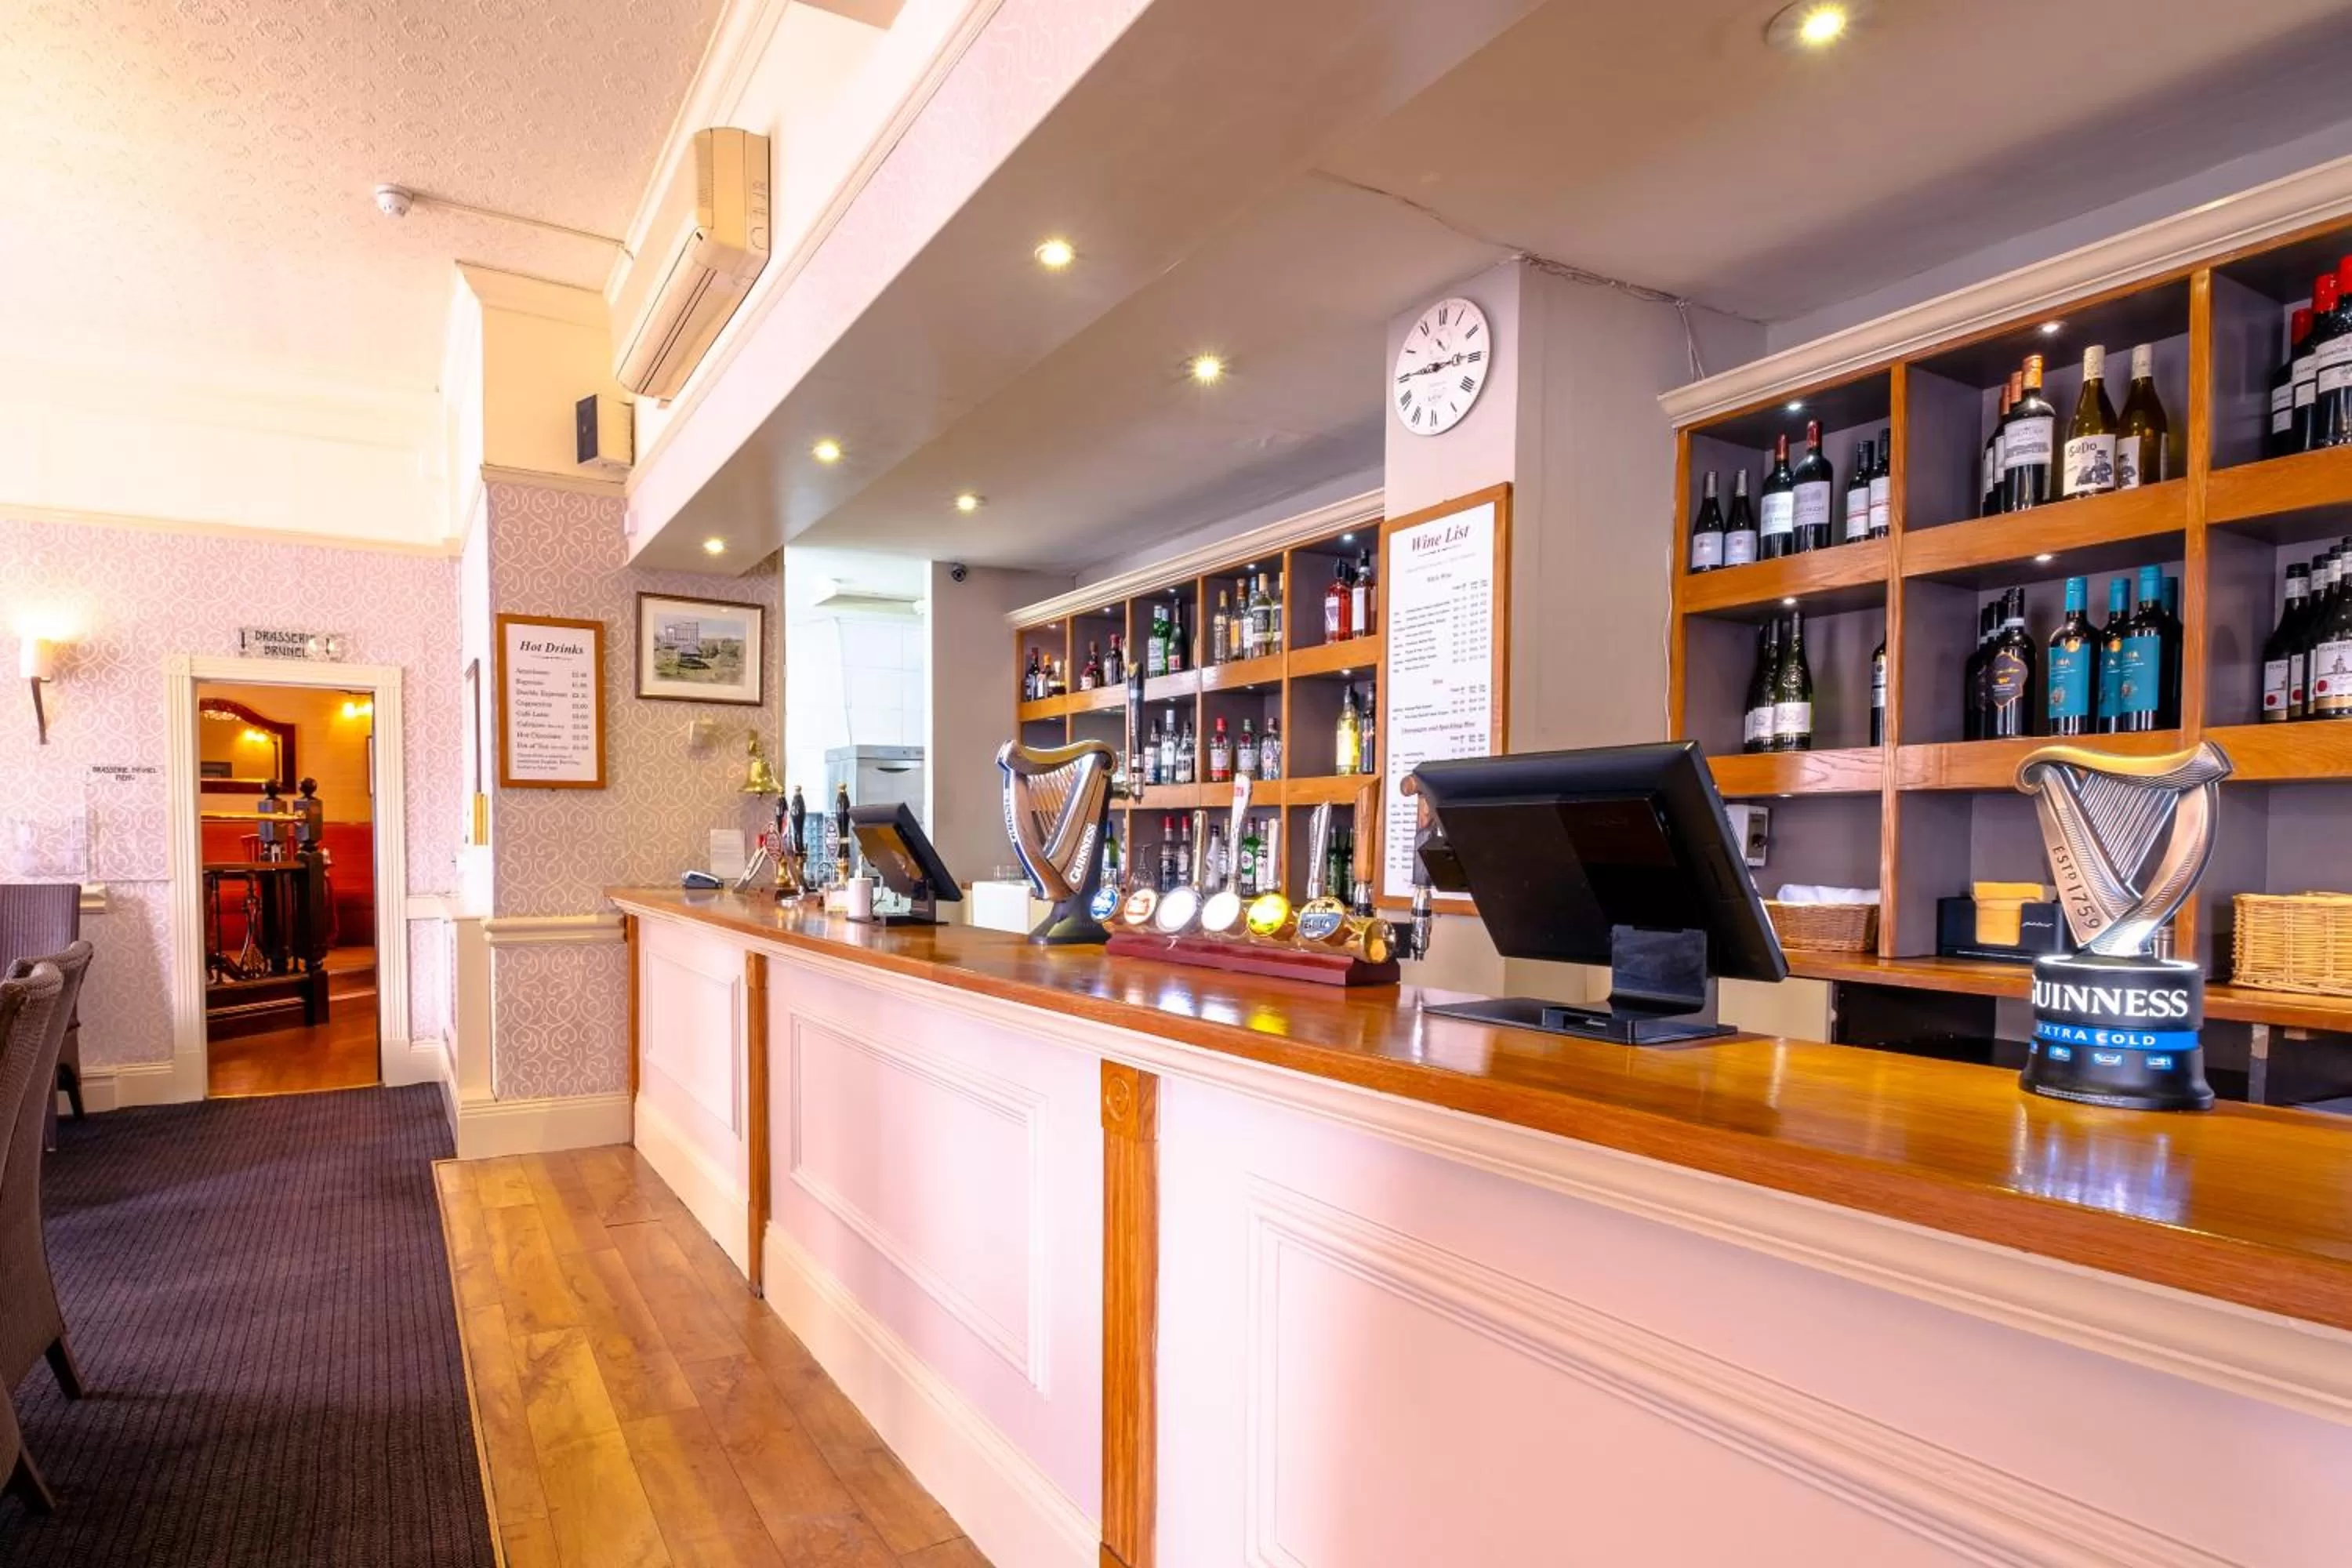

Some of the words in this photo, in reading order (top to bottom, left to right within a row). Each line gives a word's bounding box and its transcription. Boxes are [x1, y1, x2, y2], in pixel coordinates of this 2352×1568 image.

[1412, 534, 1442, 552] Wine
[1445, 524, 1470, 543] List
[520, 641, 542, 652] Hot
[545, 642, 584, 655] Drinks
[1069, 822, 1098, 884] GUINNESS
[2067, 884, 2100, 929] 1759
[2095, 1033, 2156, 1047] COLD
